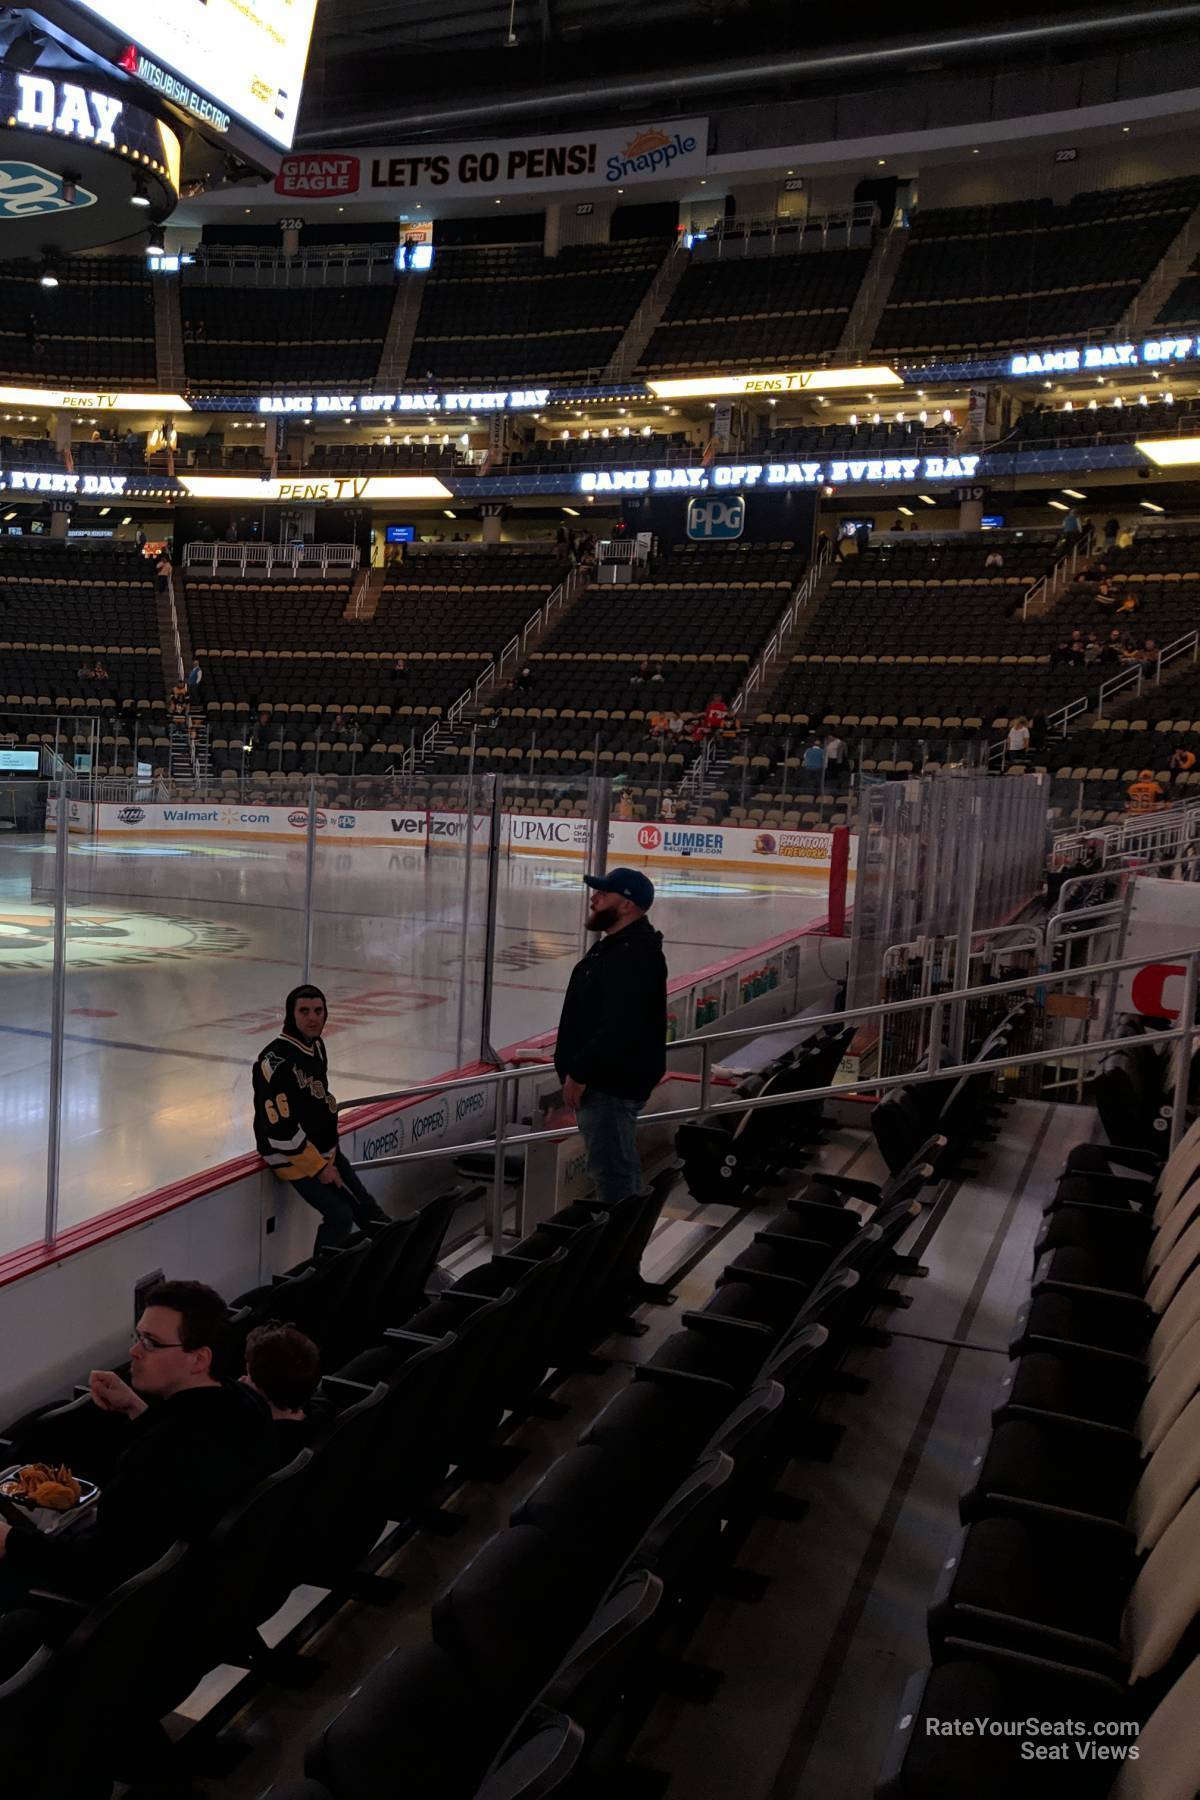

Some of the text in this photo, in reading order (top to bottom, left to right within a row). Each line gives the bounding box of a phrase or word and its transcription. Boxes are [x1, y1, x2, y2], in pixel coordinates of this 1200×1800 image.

[138, 57, 231, 133] MITSUBISHI ELECTRIC
[17, 75, 123, 147] DAY
[281, 160, 349, 177] GIANT
[371, 143, 597, 187] LET'S GO PENS!
[606, 134, 697, 182] Snapple
[283, 175, 350, 191] EAGLE
[580, 470, 650, 491] GAME
[715, 466, 762, 485] OFF
[925, 456, 979, 477] DAY
[50, 501, 72, 512] 116
[958, 488, 984, 501] 119
[690, 503, 741, 530] PPG
[163, 810, 218, 822] Walmart
[512, 820, 570, 842] UPMC
[663, 831, 723, 849] LUMBER
[779, 834, 830, 850] PHANTOM
[264, 1092, 290, 1124] 66
[411, 1110, 444, 1141] KOPPERS
[363, 1130, 399, 1161] KOPPERS
